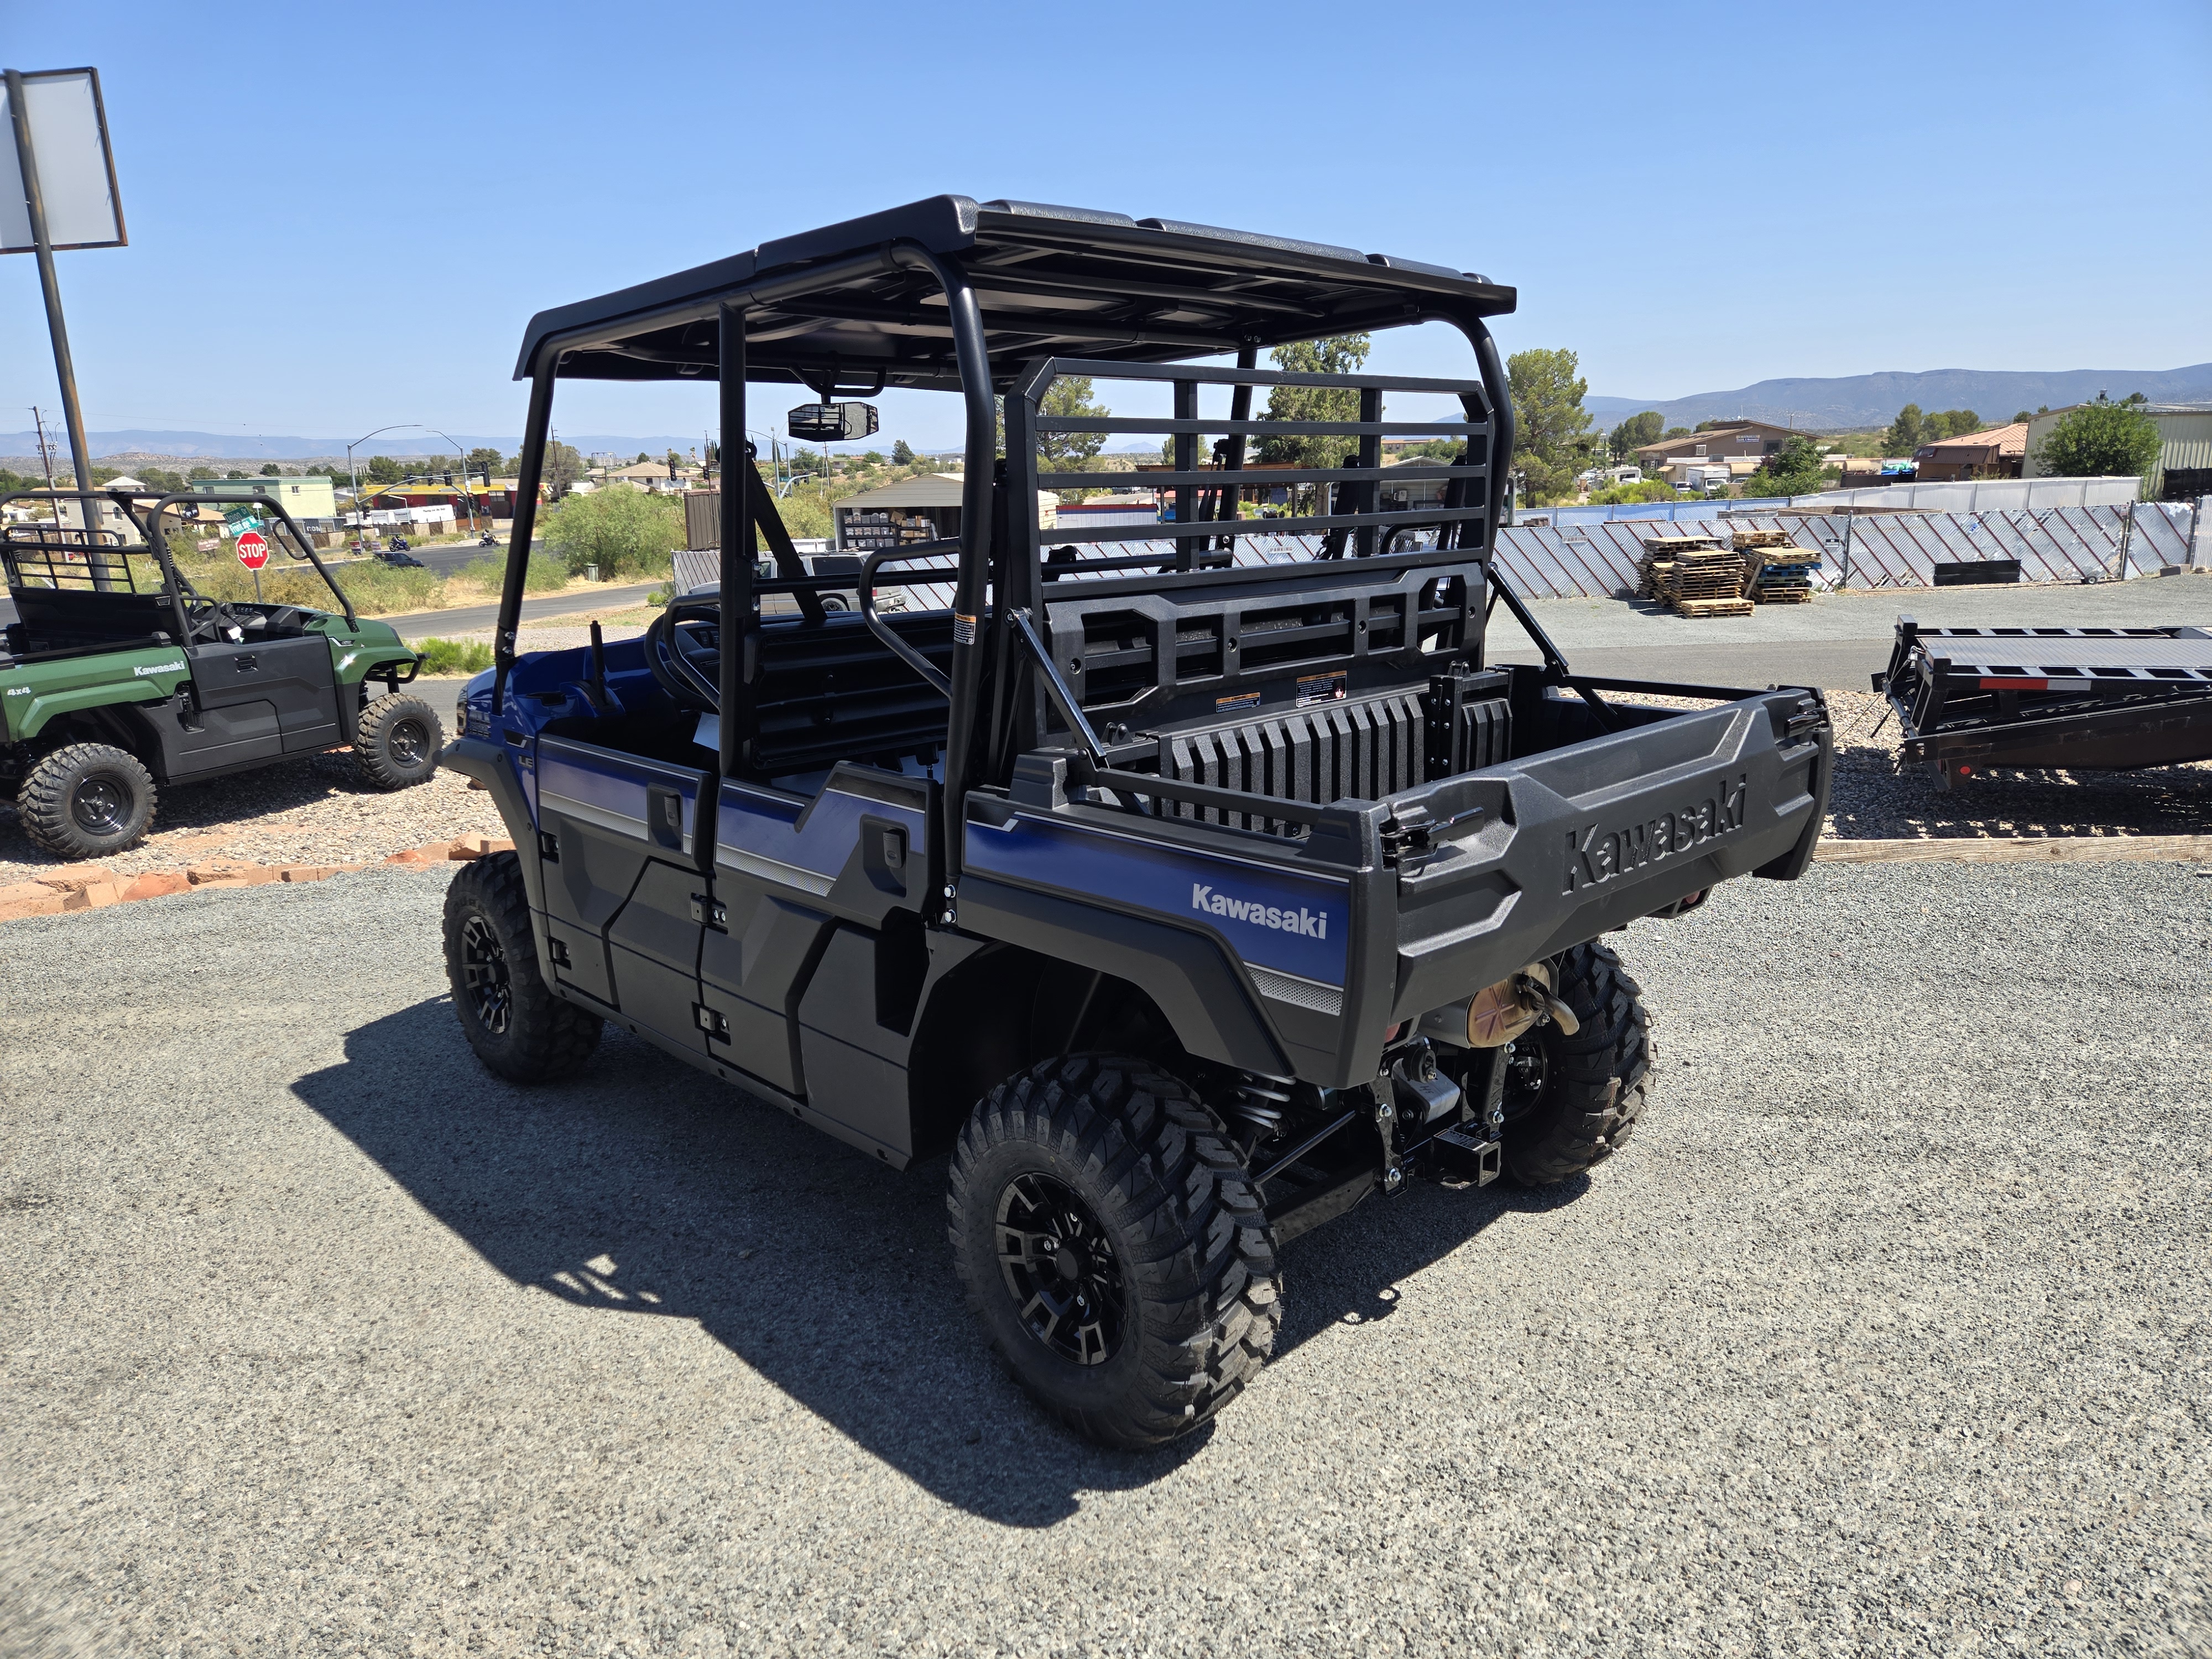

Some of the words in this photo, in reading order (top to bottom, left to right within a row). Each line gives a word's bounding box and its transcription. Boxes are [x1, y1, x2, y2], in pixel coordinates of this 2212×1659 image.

[224, 512, 242, 523] Union
[239, 543, 266, 559] STOP
[134, 661, 185, 676] Kawasaki
[7, 686, 31, 696] 4x4
[518, 754, 534, 769] LE
[1562, 773, 1747, 896] Kawasaki
[1192, 883, 1327, 940] Kawasaki
